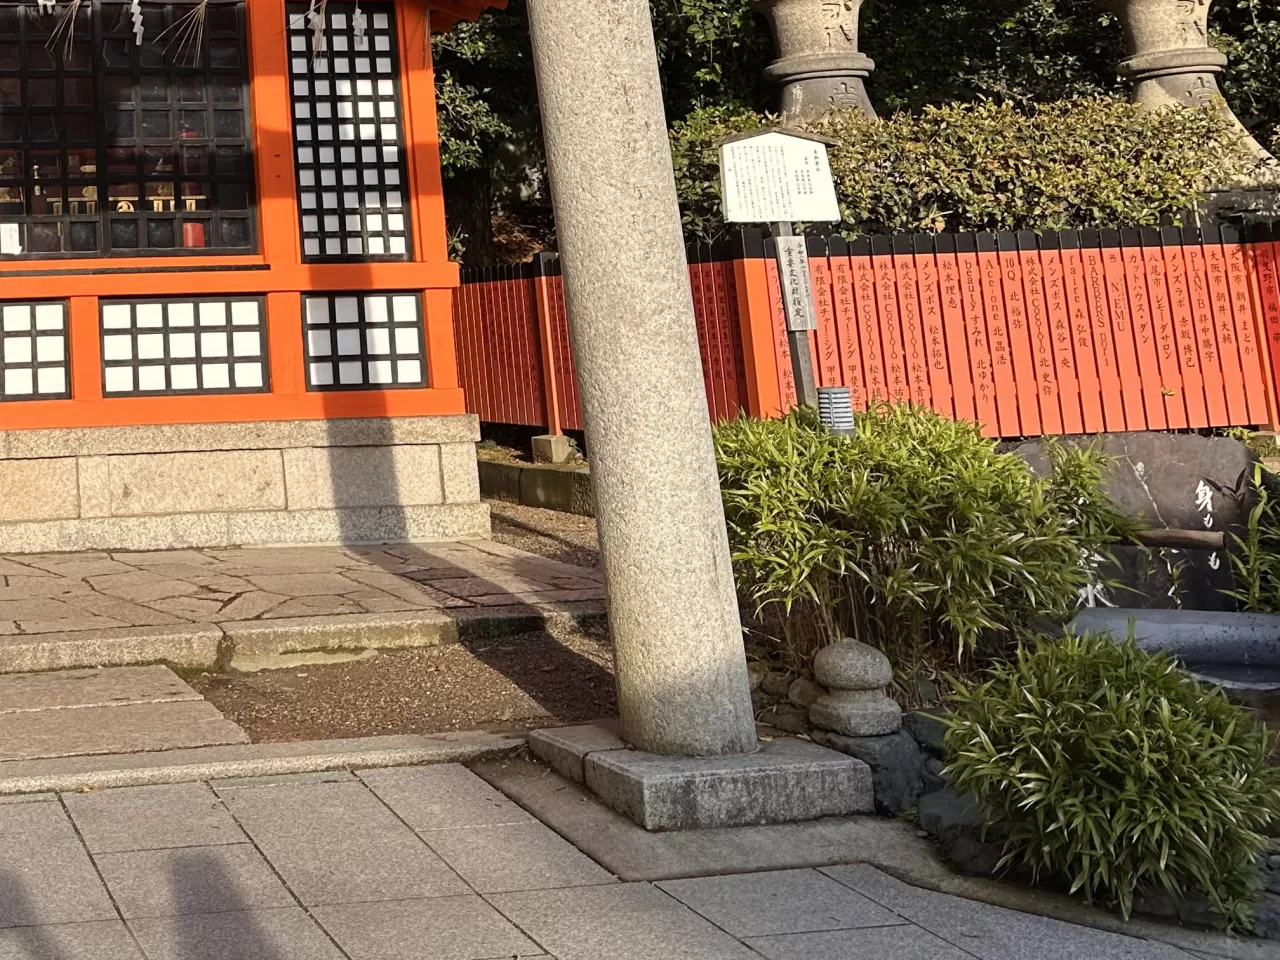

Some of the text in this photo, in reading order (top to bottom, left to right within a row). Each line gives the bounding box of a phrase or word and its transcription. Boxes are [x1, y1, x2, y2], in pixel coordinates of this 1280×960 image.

[784, 246, 805, 318] 重要文化財指定
[814, 264, 835, 360] 有限会社チャーミング
[836, 263, 857, 360] 有限会社チャーミング
[922, 260, 945, 370] メンズボス 松本拓也
[942, 260, 958, 309] 松本理恵
[964, 260, 977, 311] beauty
[971, 314, 983, 347] すみれ
[1047, 256, 1062, 311] メンズボス
[1069, 255, 1080, 303] faire
[1088, 255, 1109, 366] BARBERS nori
[1129, 254, 1150, 344] カットハウス・ダン
[1148, 253, 1172, 360] 八尾市 レモーダサロン
[1170, 252, 1186, 308] メンズラボ
[1210, 250, 1222, 286] 大阪市
[1216, 292, 1227, 316] 朝井
[1230, 250, 1253, 355] 大阪市 朝井 まどか
